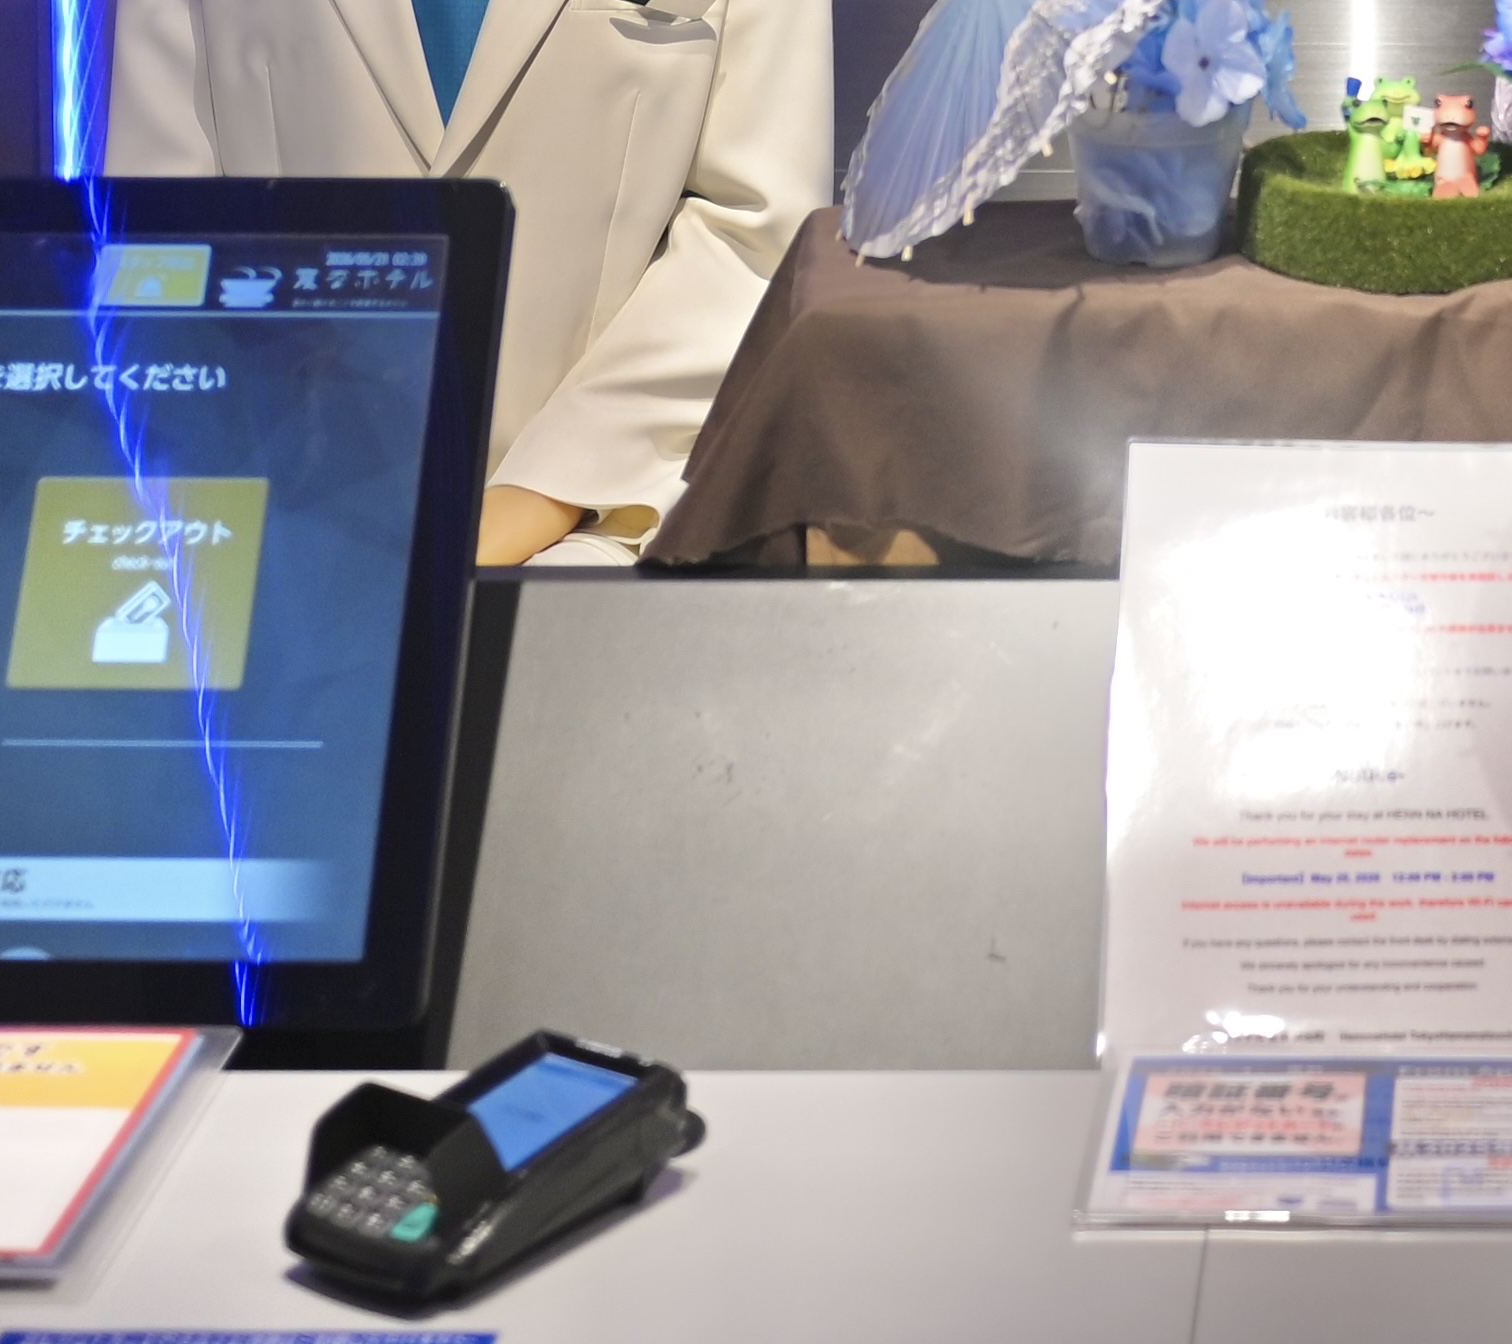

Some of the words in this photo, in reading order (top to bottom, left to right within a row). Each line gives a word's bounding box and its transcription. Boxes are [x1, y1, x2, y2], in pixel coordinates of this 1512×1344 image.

[63, 520, 232, 545] チェックアウト
